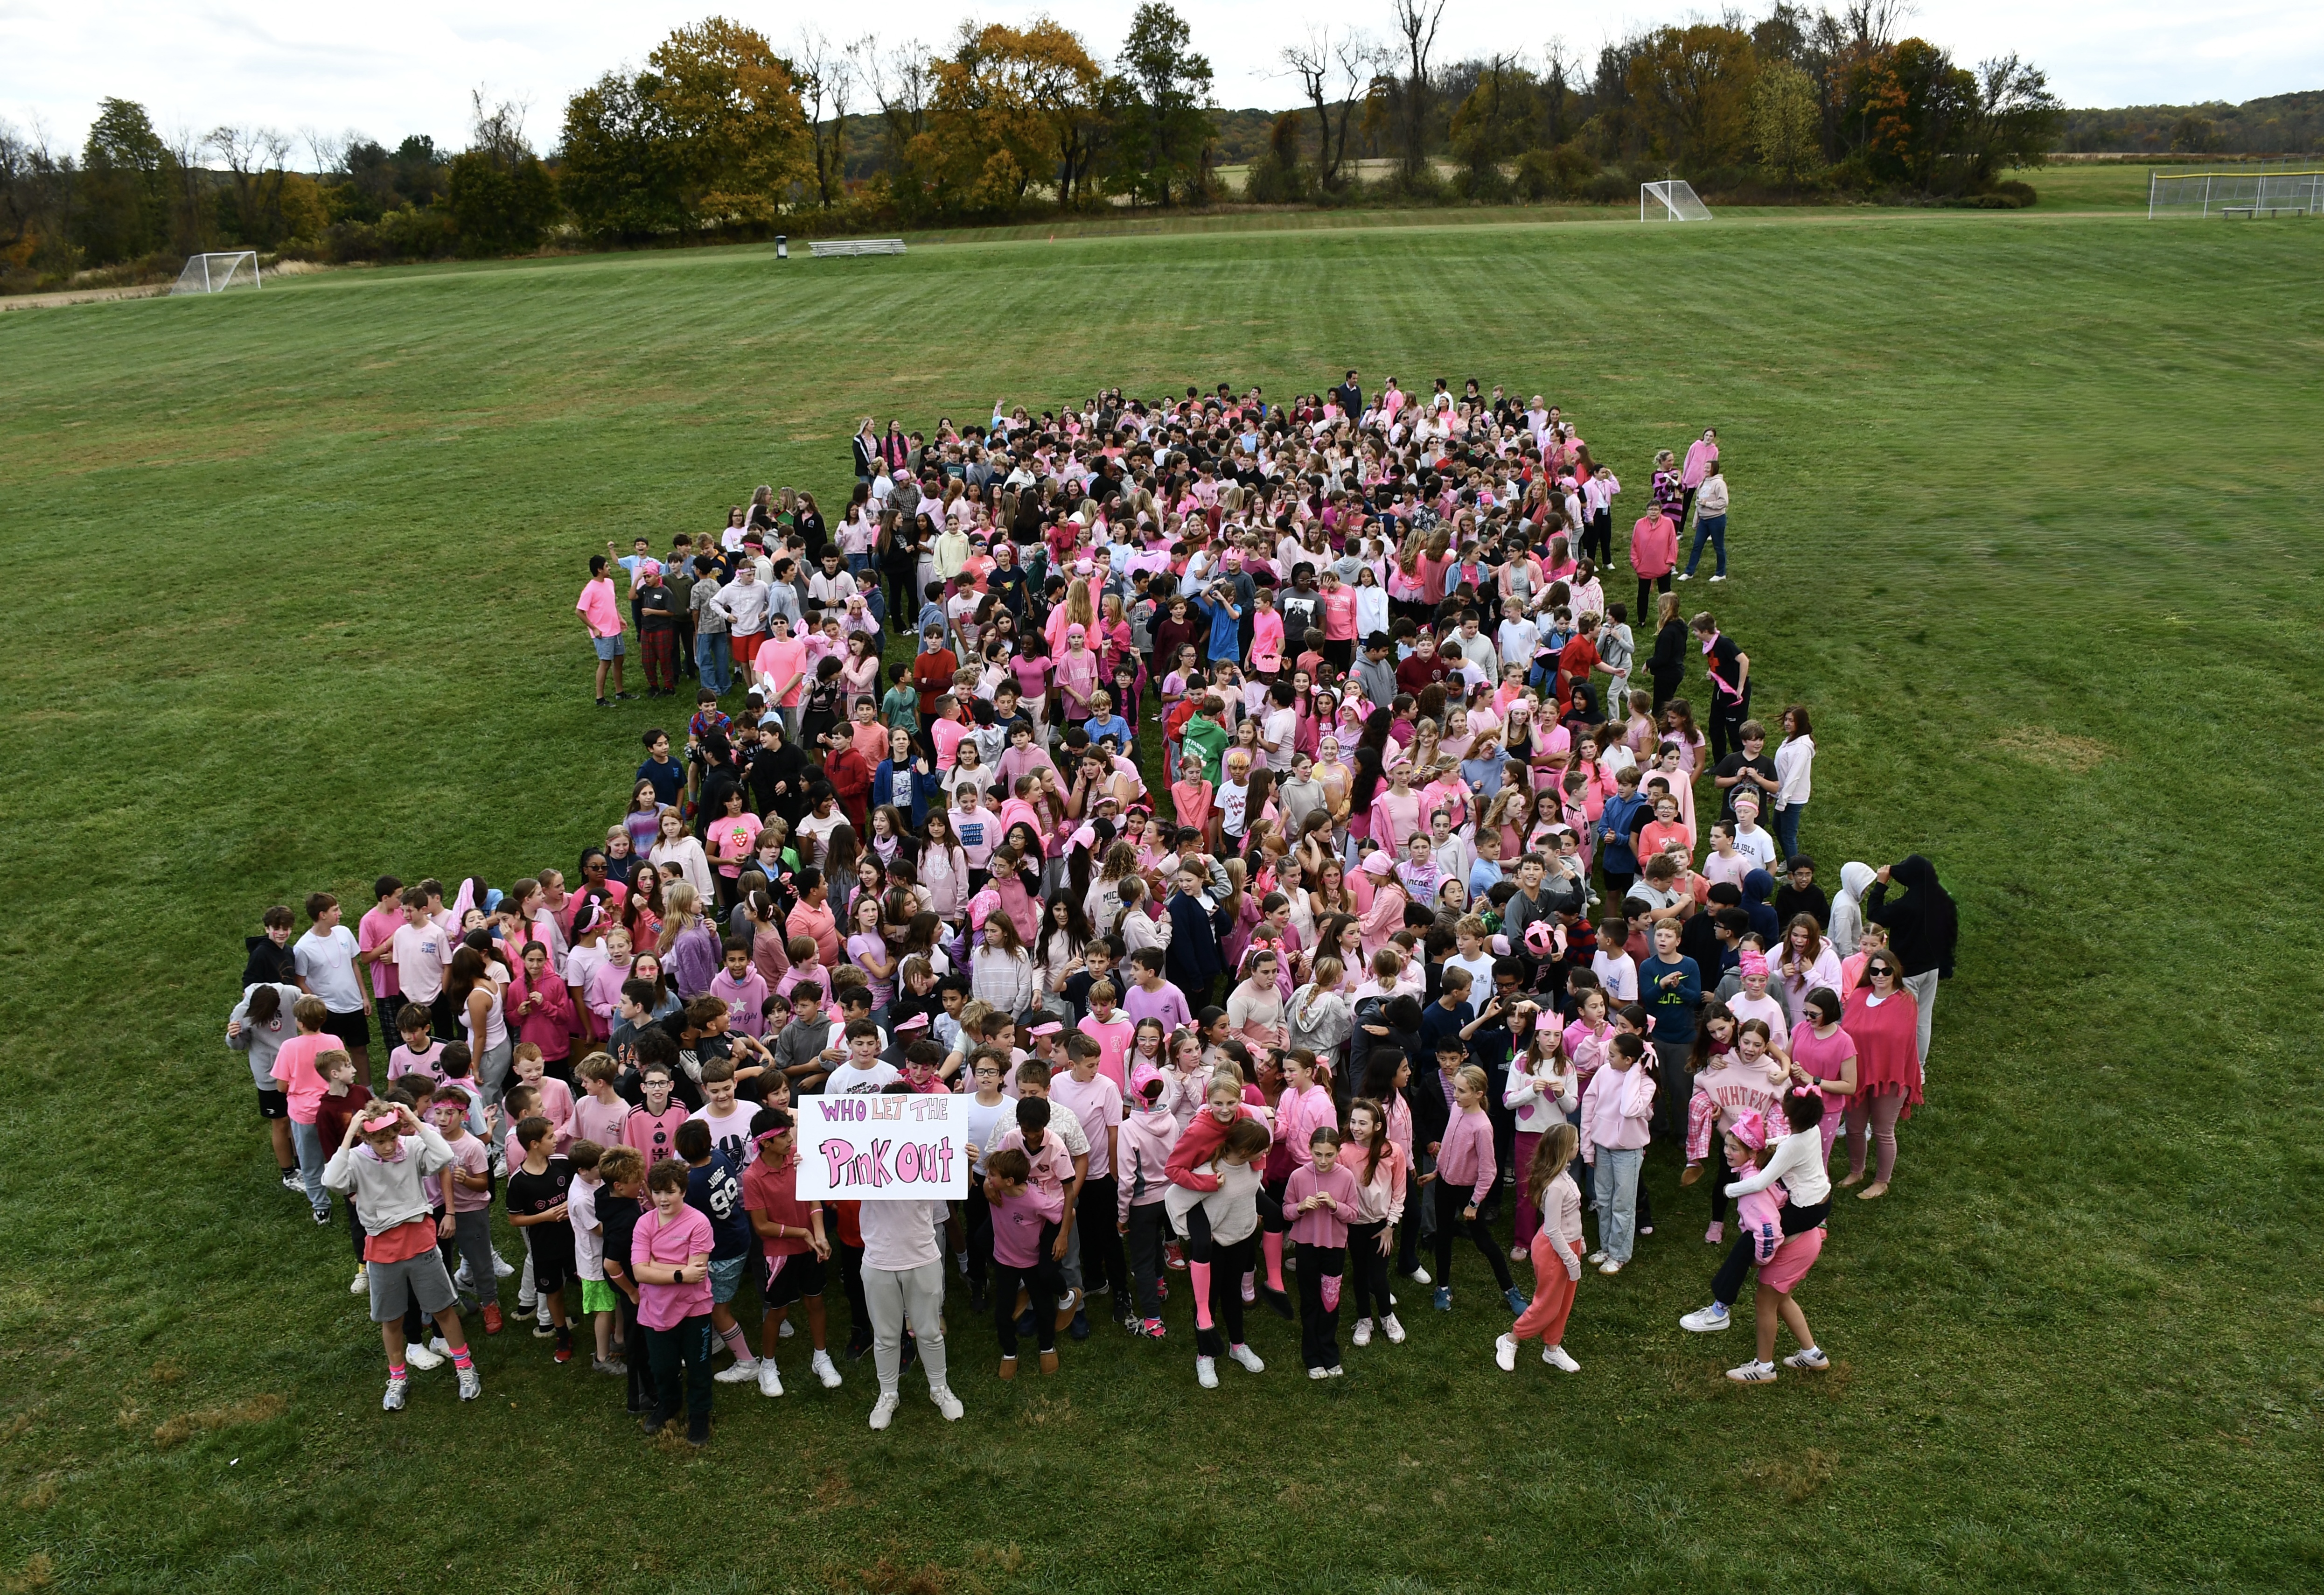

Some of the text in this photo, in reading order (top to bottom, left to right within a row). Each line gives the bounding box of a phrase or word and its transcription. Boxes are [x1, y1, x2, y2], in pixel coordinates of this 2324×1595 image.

[1741, 844, 1755, 855] ISLE
[846, 1082, 867, 1093] ROMP
[1717, 1085, 1768, 1111] WHT FX
[818, 1095, 948, 1121] WHO LET THE
[708, 1166, 726, 1189] JUDGE
[548, 1192, 565, 1206] XBTO
[710, 1177, 738, 1220] 99
[700, 1336, 710, 1362] Hurley
